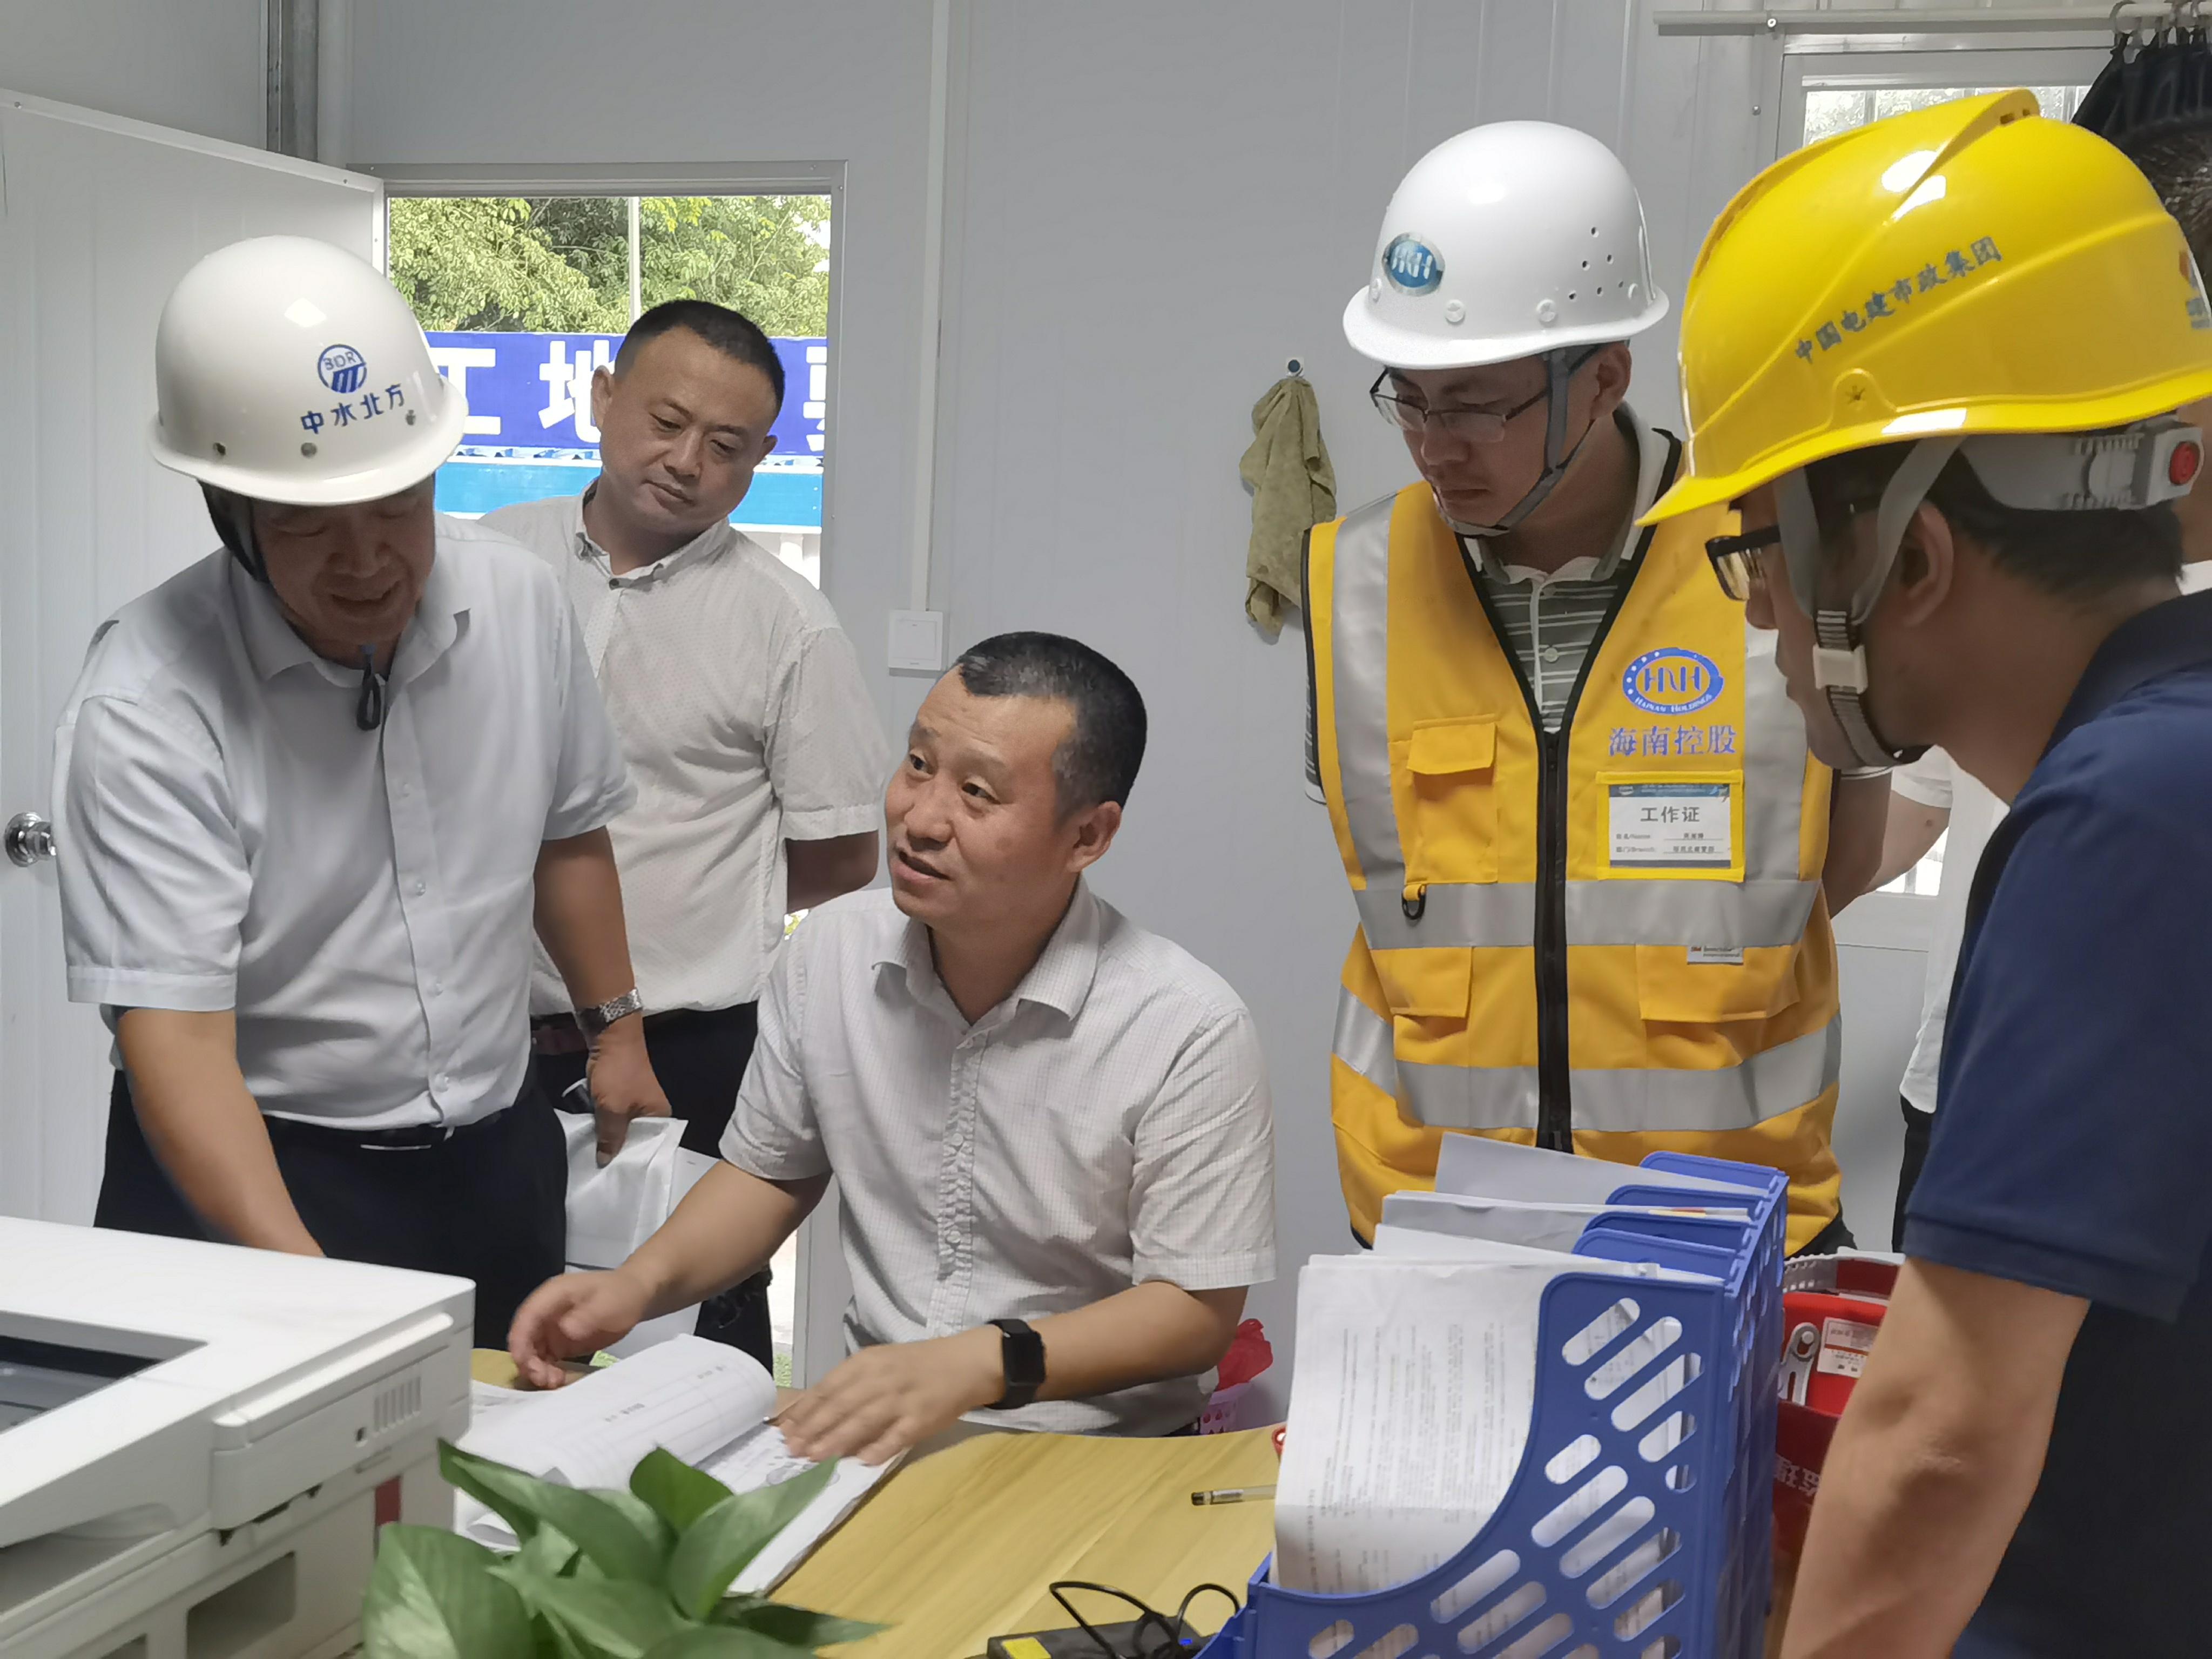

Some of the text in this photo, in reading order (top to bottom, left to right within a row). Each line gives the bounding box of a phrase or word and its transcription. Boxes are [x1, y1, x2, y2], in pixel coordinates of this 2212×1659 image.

[1796, 236, 2002, 364] 中国电建市政集团
[324, 350, 357, 371] BDR
[300, 383, 405, 435] 中水北方
[1609, 725, 1736, 756] 海南控股
[1640, 806, 1700, 823] 工作证
